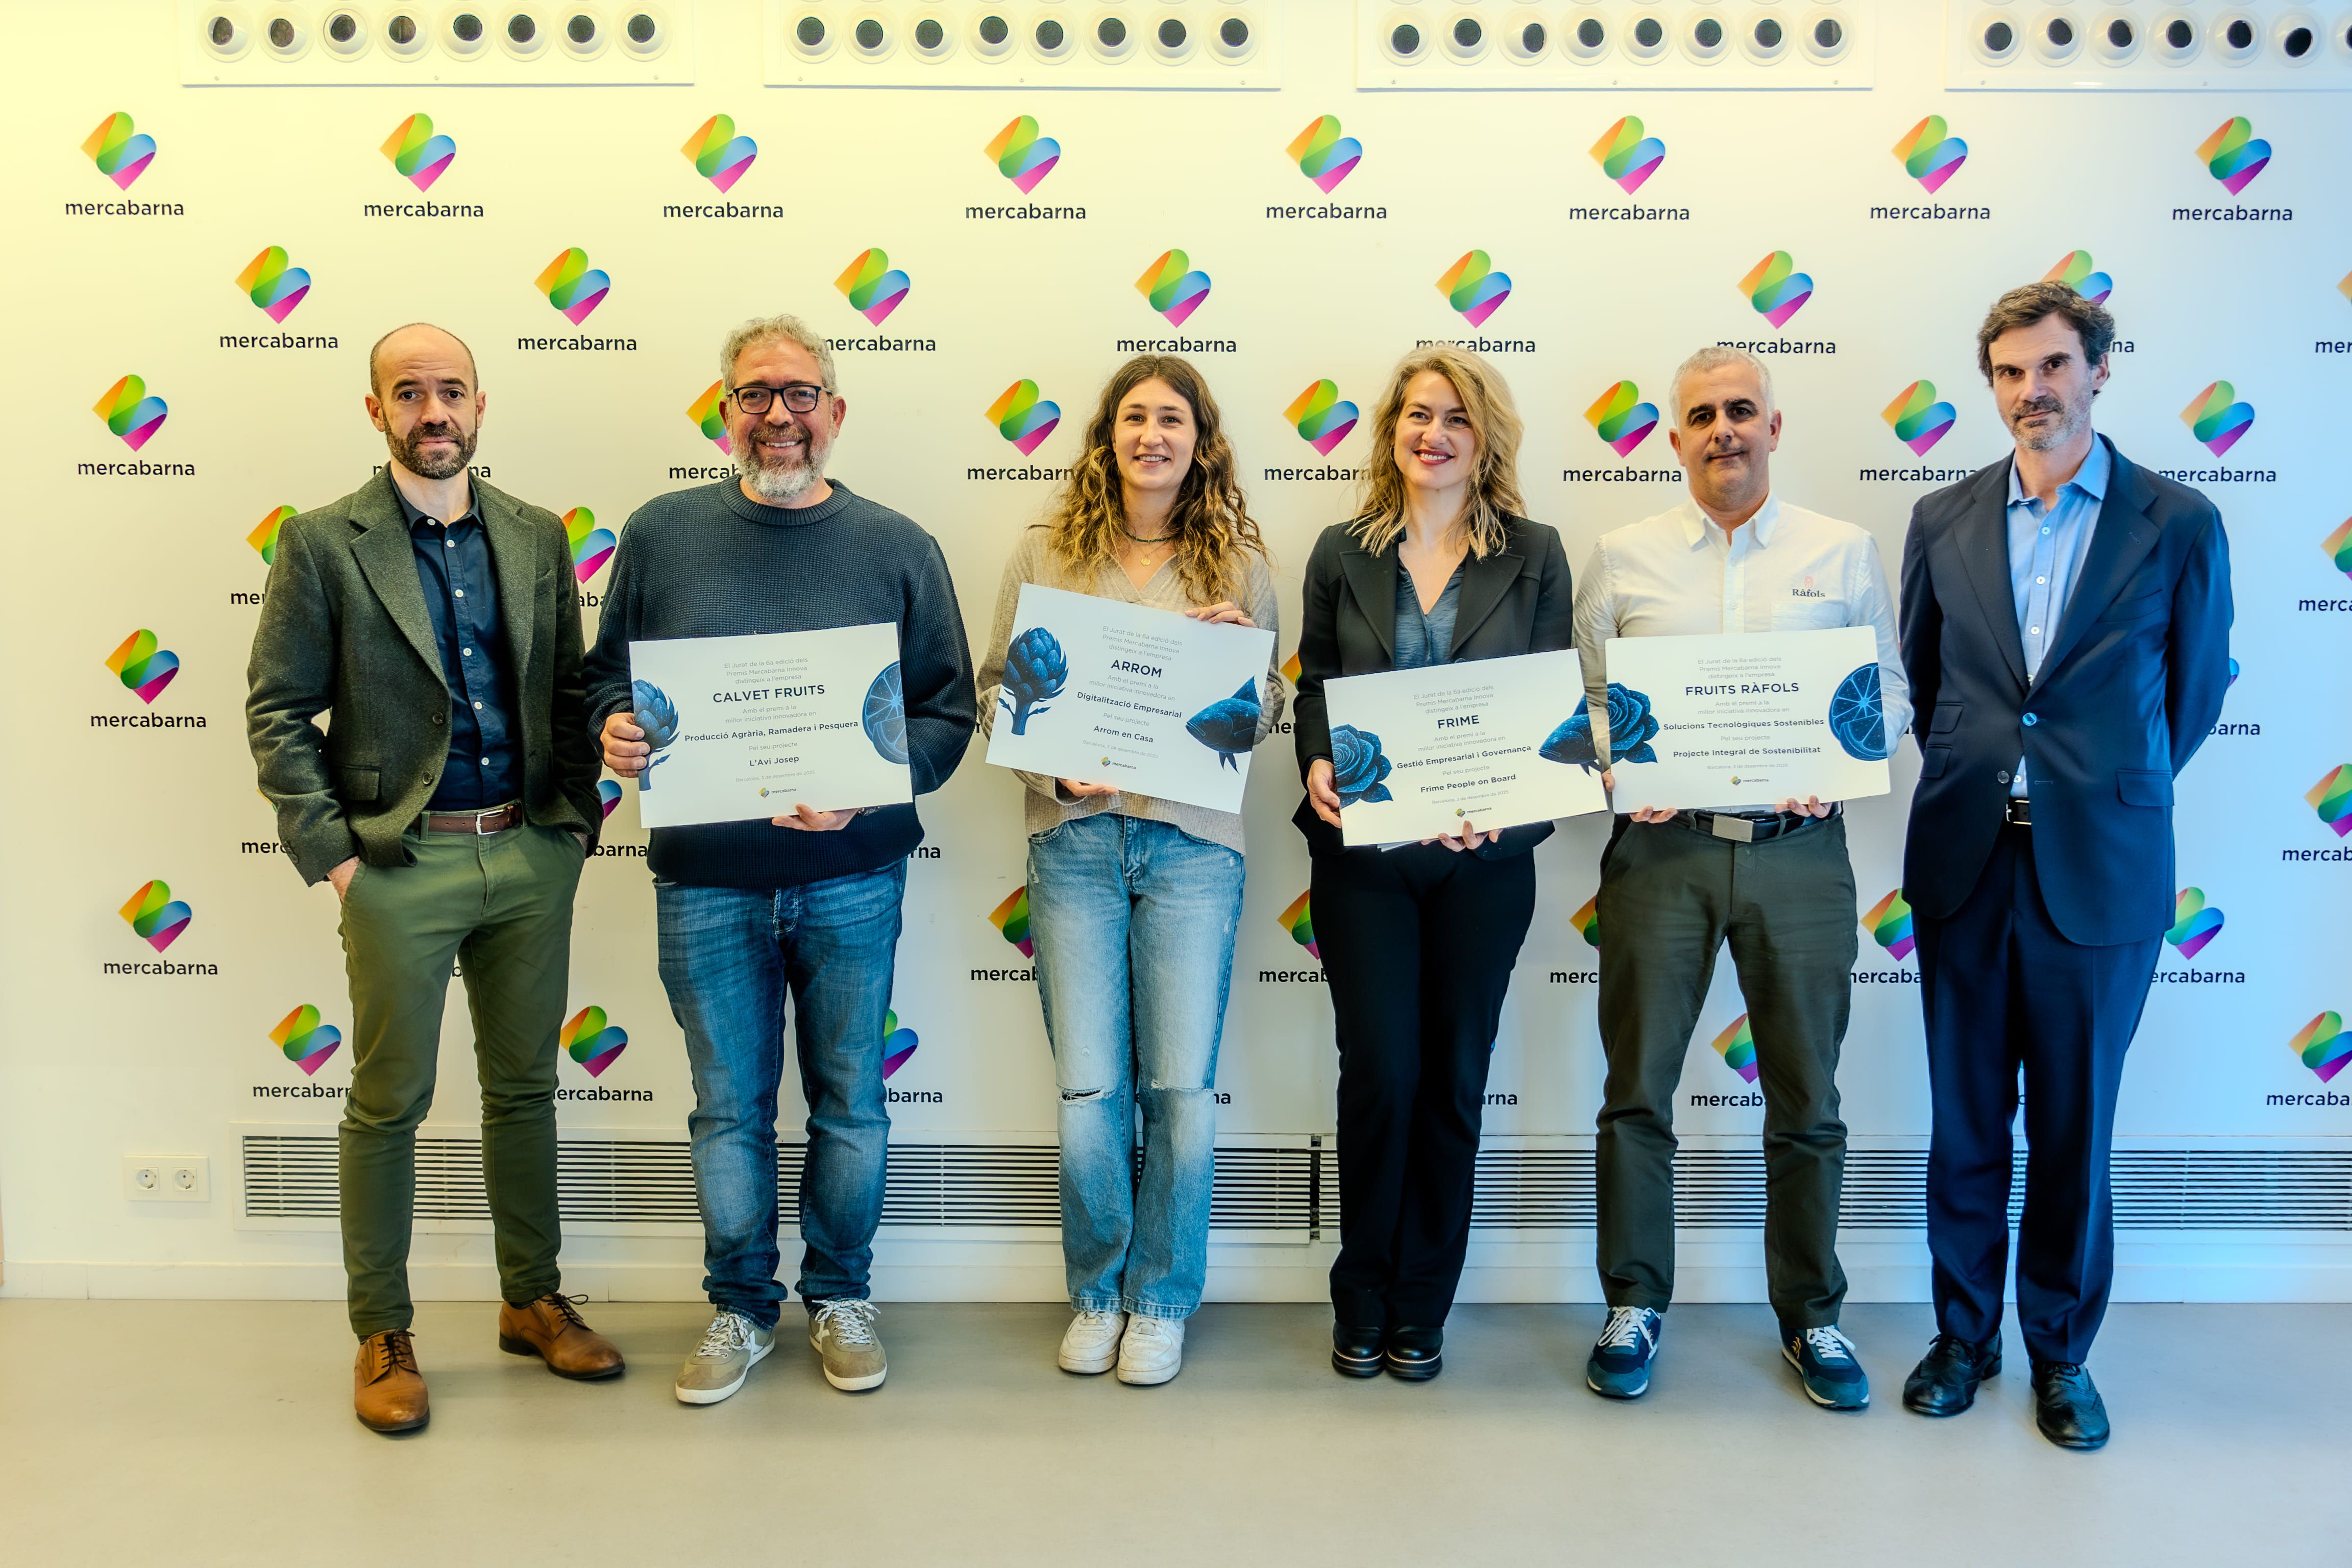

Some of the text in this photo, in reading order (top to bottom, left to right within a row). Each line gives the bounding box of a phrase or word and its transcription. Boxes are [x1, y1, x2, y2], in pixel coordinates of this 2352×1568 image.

[66, 200, 183, 215] mercabarna
[364, 201, 483, 217] mercabarna
[664, 202, 783, 217] mercabarna
[966, 204, 1085, 219] mercabarna
[1267, 203, 1386, 218] mercabarna
[1570, 205, 1689, 220] mercabarna
[1871, 204, 1990, 219] mercabarna
[2173, 205, 2292, 220] mercabarna
[220, 333, 337, 348] mercabarna
[519, 335, 636, 350] mercabarna
[1117, 336, 1236, 352] mercabarna
[79, 460, 194, 475] mercabarna
[968, 465, 1074, 480] mercabarn
[1563, 467, 1681, 481] mercabarna
[1792, 589, 1825, 597] Ràfols
[1103, 634, 1179, 653] Premis Mercabarna Innova
[1109, 644, 1137, 654] distingeix
[1143, 652, 1171, 660] l'empresa
[1111, 660, 1162, 677] ARROM
[713, 685, 824, 702] CALVET FRUITS
[1107, 683, 1133, 693] iniciativa
[1134, 690, 1166, 699] innovadora
[1686, 682, 1799, 695] FRUITS RÀFOLS
[1077, 692, 1182, 718] Digitalització Empresarial
[91, 713, 206, 727] mercabarna
[1438, 715, 1479, 728] FRIME
[685, 732, 728, 741] Producció
[732, 730, 765, 739] Agrària,
[769, 726, 811, 735] Ramadera
[1094, 726, 1119, 736] Arrom
[1135, 734, 1153, 743] Casa
[750, 758, 771, 766] L'Avi
[1397, 760, 1423, 768] Gestió
[1426, 753, 1474, 765] Empresarial
[1482, 746, 1531, 756] Governança
[1447, 780, 1475, 789] People
[1491, 774, 1515, 782] Board
[2283, 846, 2352, 861] mercab
[104, 960, 217, 975] mercabarna
[553, 1086, 652, 1101] ercabarna
[888, 1088, 942, 1102] barna
[1691, 1092, 1763, 1107] mercab
[2267, 1091, 2350, 1106] mercaba
